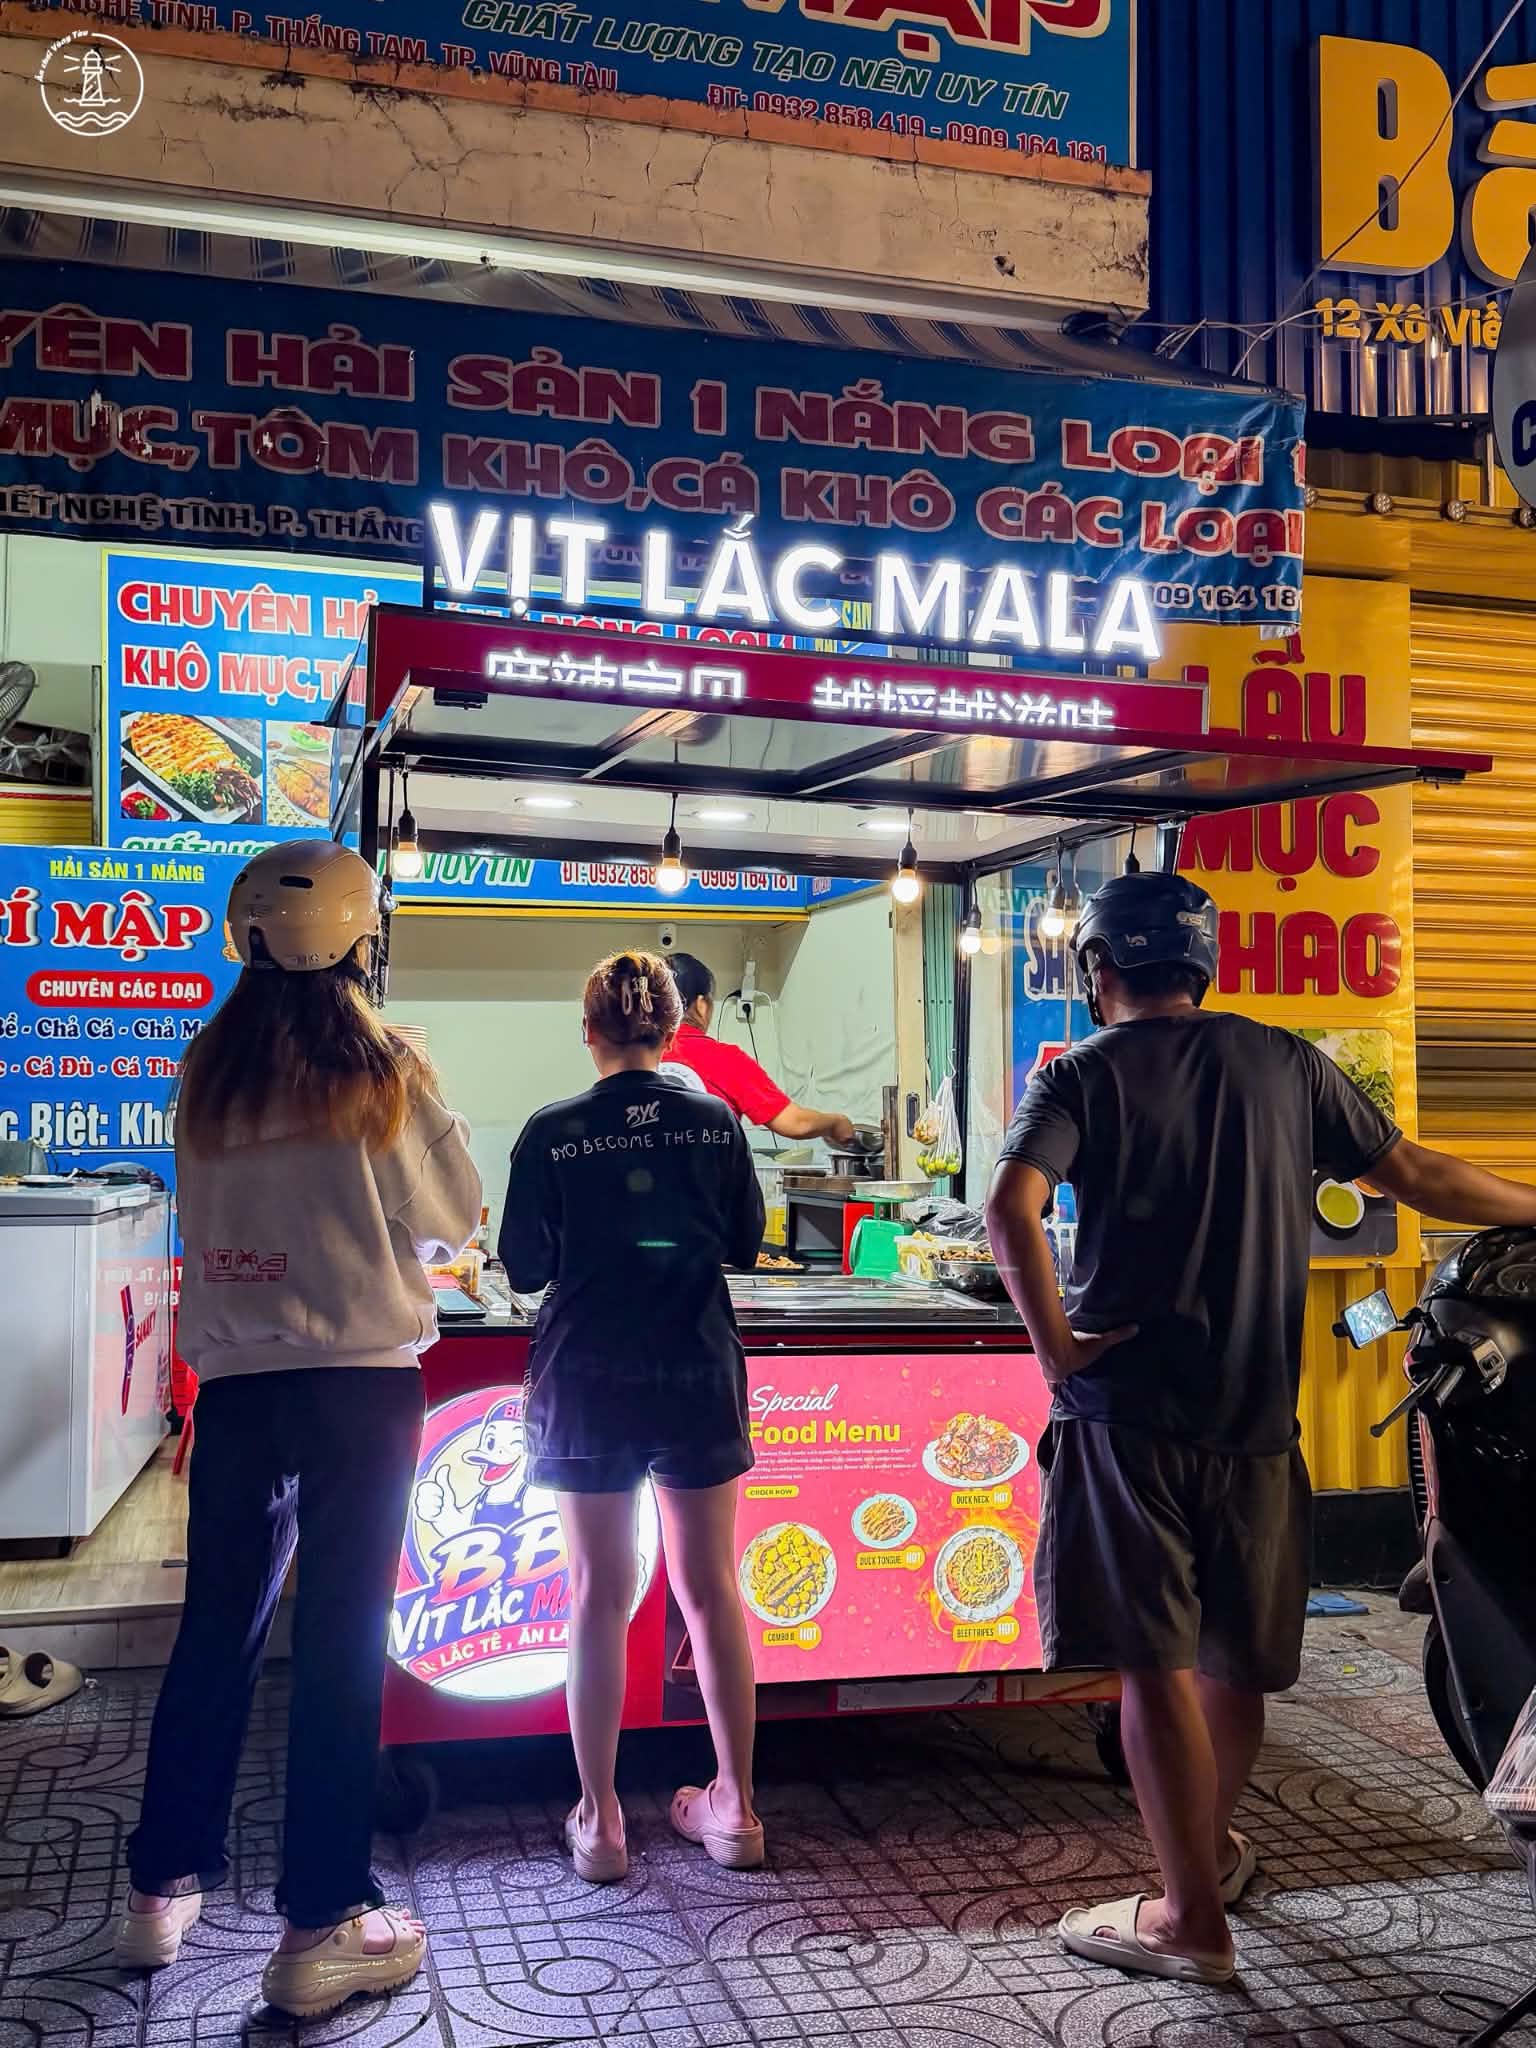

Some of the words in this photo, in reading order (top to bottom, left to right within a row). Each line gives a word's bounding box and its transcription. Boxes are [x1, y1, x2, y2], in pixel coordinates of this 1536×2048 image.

[265, 15, 361, 53] THẮNG
[488, 51, 562, 82] VŨNG
[566, 62, 618, 92] TÀU
[462, 0, 591, 44] CHẤT
[594, 18, 743, 66] LƯỢNG
[752, 40, 836, 84] TẠO
[840, 58, 933, 98] NÊN
[936, 72, 996, 107] UY
[1001, 82, 1070, 121] TÍN
[753, 91, 818, 120] 0932
[823, 102, 874, 129] 858
[877, 112, 926, 136] 419
[945, 121, 1010, 149] 0909
[1016, 132, 1061, 157] 164
[1067, 141, 1107, 164] 181
[226, 323, 416, 402] HẢI
[447, 346, 661, 429] SẢN
[690, 379, 727, 436] 1
[755, 379, 1035, 465] NẮNG
[1061, 418, 1264, 496] LOẠI
[780, 469, 956, 533] KHÔ
[976, 482, 1123, 547] CÁC
[1140, 500, 1304, 567] LOẠI
[63, 492, 162, 533] NGHỆ
[310, 506, 424, 548] THẮNG
[1197, 584, 1256, 611] 164
[430, 503, 607, 616] VỊT
[645, 513, 846, 630] LẮC
[878, 553, 1161, 660] MALA
[117, 580, 312, 637] CHUYÊN
[121, 640, 211, 692] KHÔ
[1179, 792, 1380, 892] MỤC
[49, 857, 83, 878] HẢI
[88, 857, 128, 880] SẢN
[135, 863, 144, 879] 1
[151, 858, 205, 882] NẮNG
[51, 888, 213, 962] MẬP
[39, 977, 114, 998] CHUYÊN
[120, 978, 156, 999] CÁC
[161, 981, 202, 1002] LOẠI
[36, 1015, 80, 1040] Chả
[86, 1017, 115, 1040] Cá
[133, 1015, 176, 1040] Chả
[24, 1056, 55, 1077] Cá
[60, 1056, 95, 1078] Đù
[112, 1056, 141, 1078] Cá
[31, 1101, 110, 1156] Biệt:
[583, 1133, 655, 1155] BECOME
[664, 1128, 697, 1146] THE
[749, 1383, 840, 1421] Special
[748, 1419, 817, 1445] Food
[824, 1419, 901, 1444] Menu
[956, 1495, 973, 1505] DUCK
[973, 1495, 990, 1504] NECK
[859, 1556, 876, 1566] DUCK
[876, 1555, 902, 1565] TONGUE
[392, 1594, 459, 1657] VỊT
[461, 1581, 525, 1635] LẮC
[767, 1633, 789, 1642] COMBO
[972, 1628, 994, 1637] TRIPES
